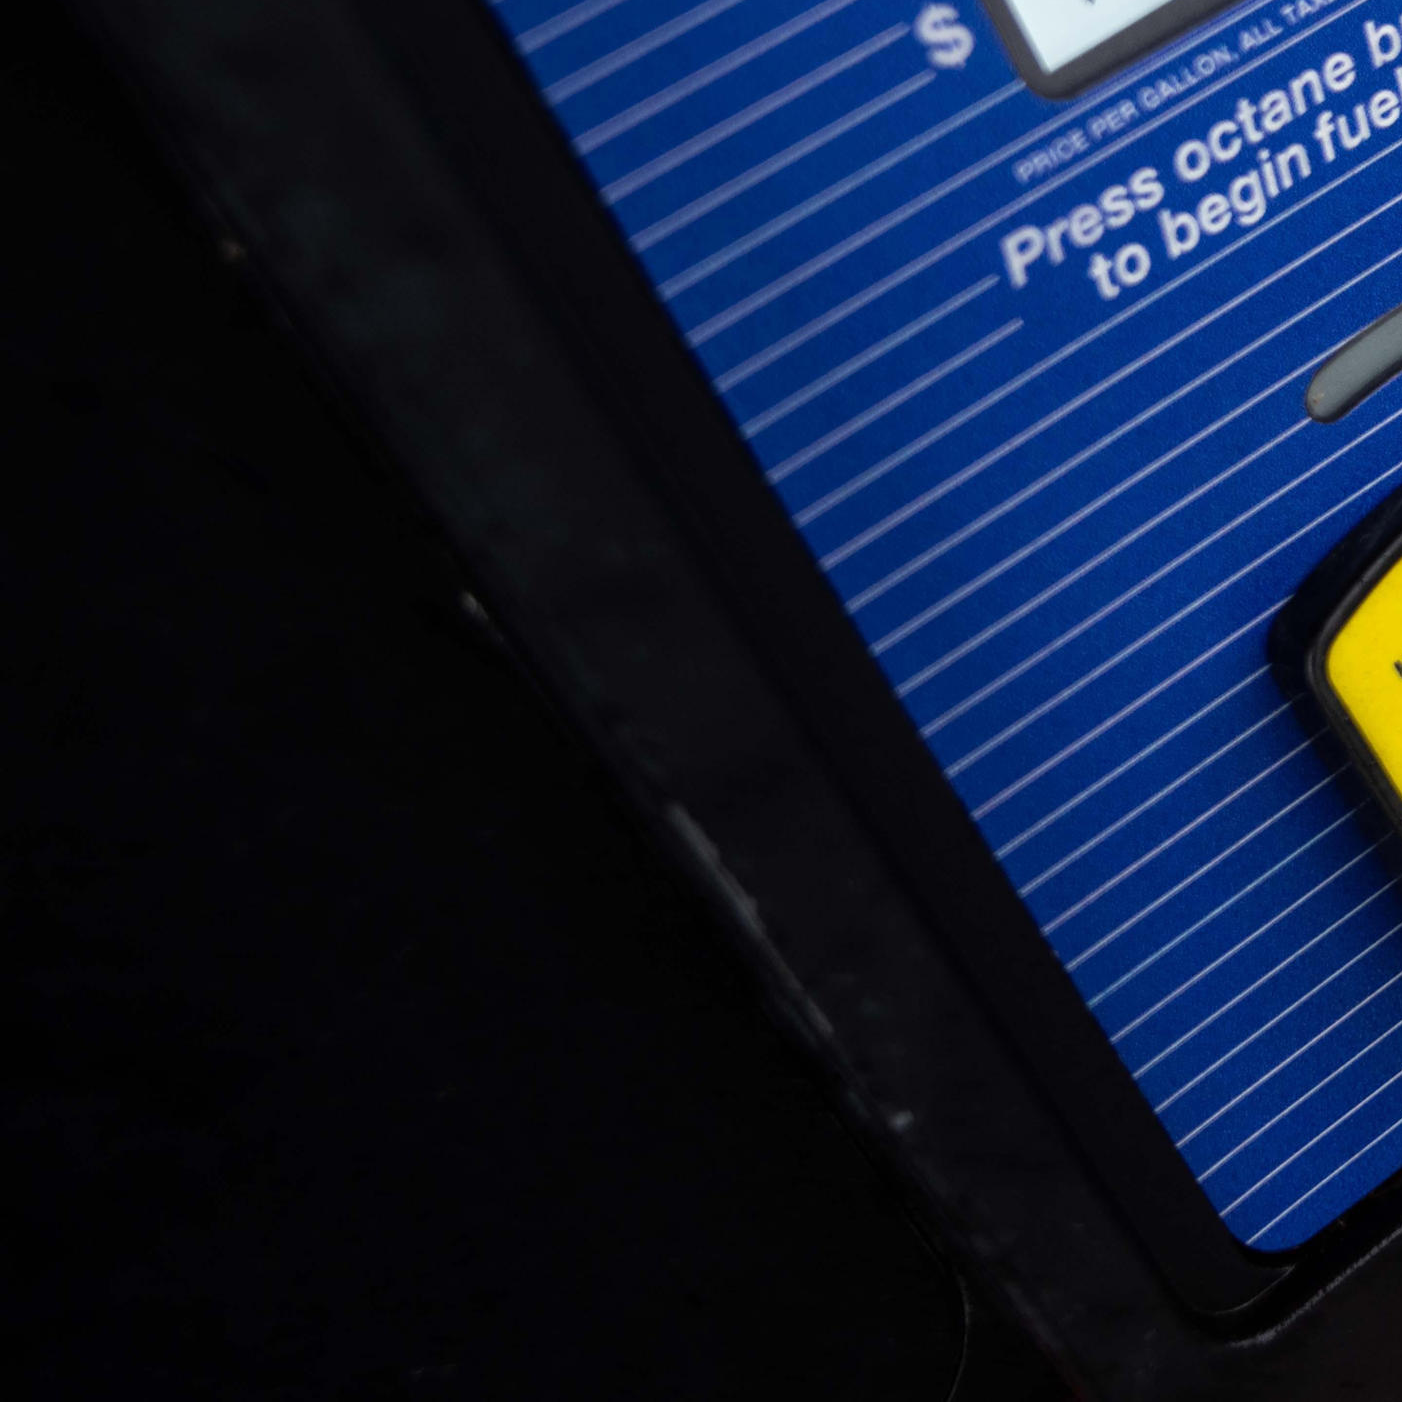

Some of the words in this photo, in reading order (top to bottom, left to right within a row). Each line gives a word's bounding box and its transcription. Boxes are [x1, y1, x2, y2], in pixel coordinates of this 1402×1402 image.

[914, 3, 974, 68] $
[1012, 128, 1090, 184] PRICE
[1087, 99, 1139, 139] PER
[1239, 19, 1283, 52] ALL
[1001, 166, 1164, 289] Press
[1174, 52, 1356, 182] octane
[1089, 244, 1151, 299] to
[1160, 143, 1311, 259] begin
